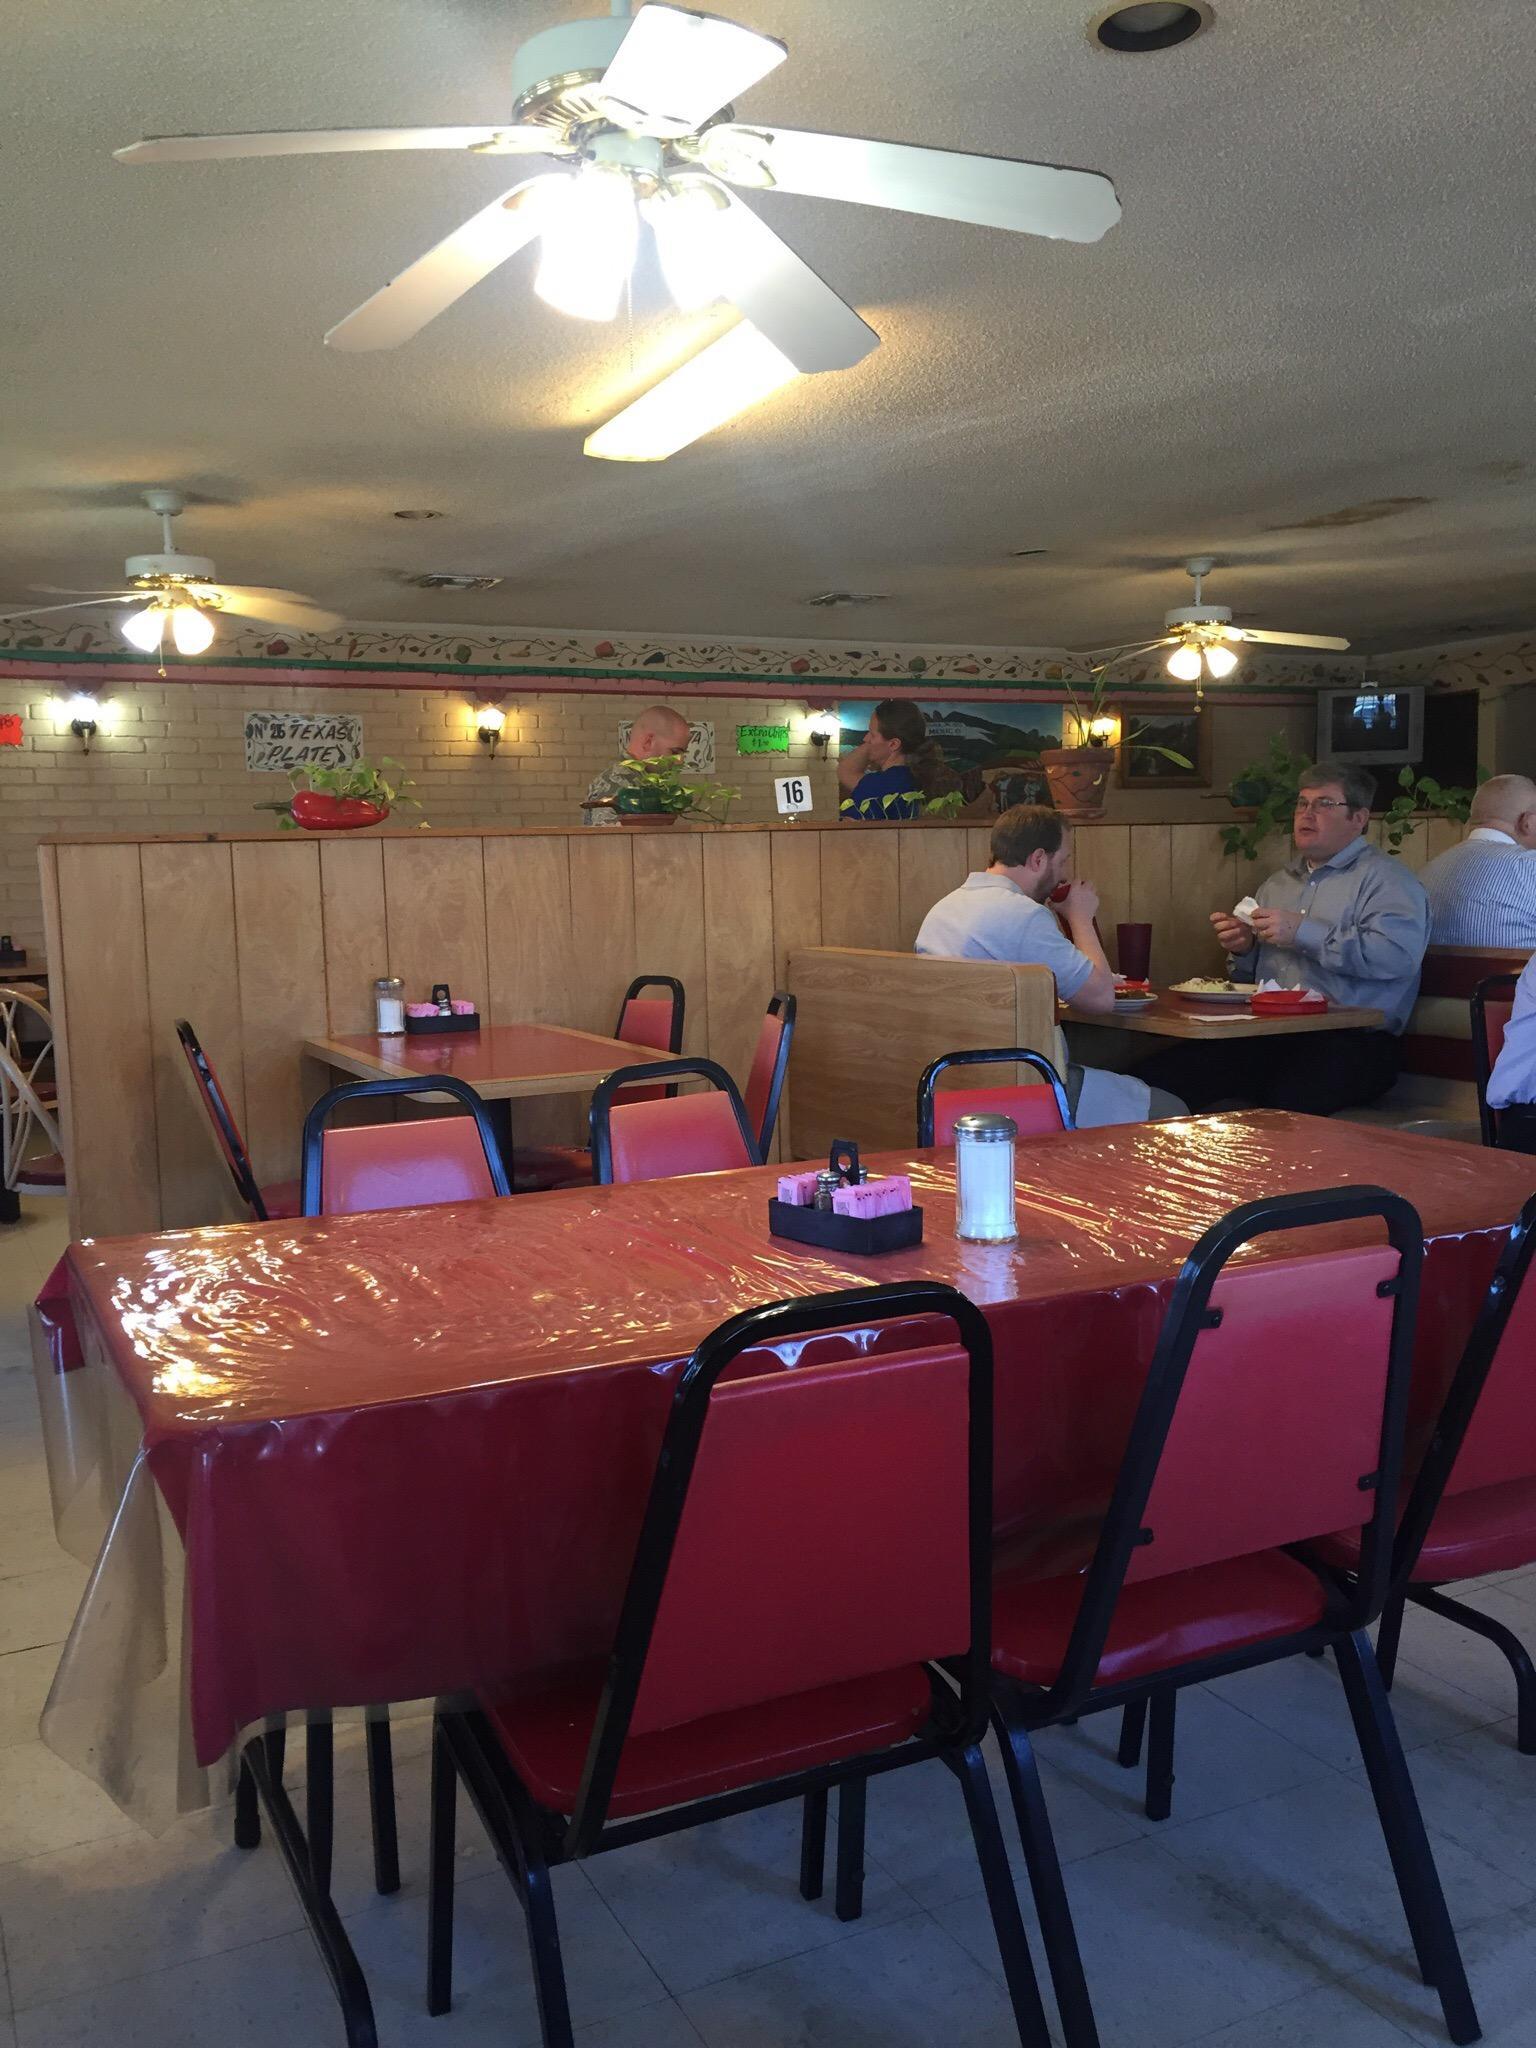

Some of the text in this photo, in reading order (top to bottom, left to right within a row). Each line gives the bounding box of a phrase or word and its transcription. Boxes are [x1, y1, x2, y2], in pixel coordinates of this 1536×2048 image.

[288, 723, 347, 740] TEXAS
[267, 745, 338, 762] PLATE
[782, 780, 804, 804] 16
